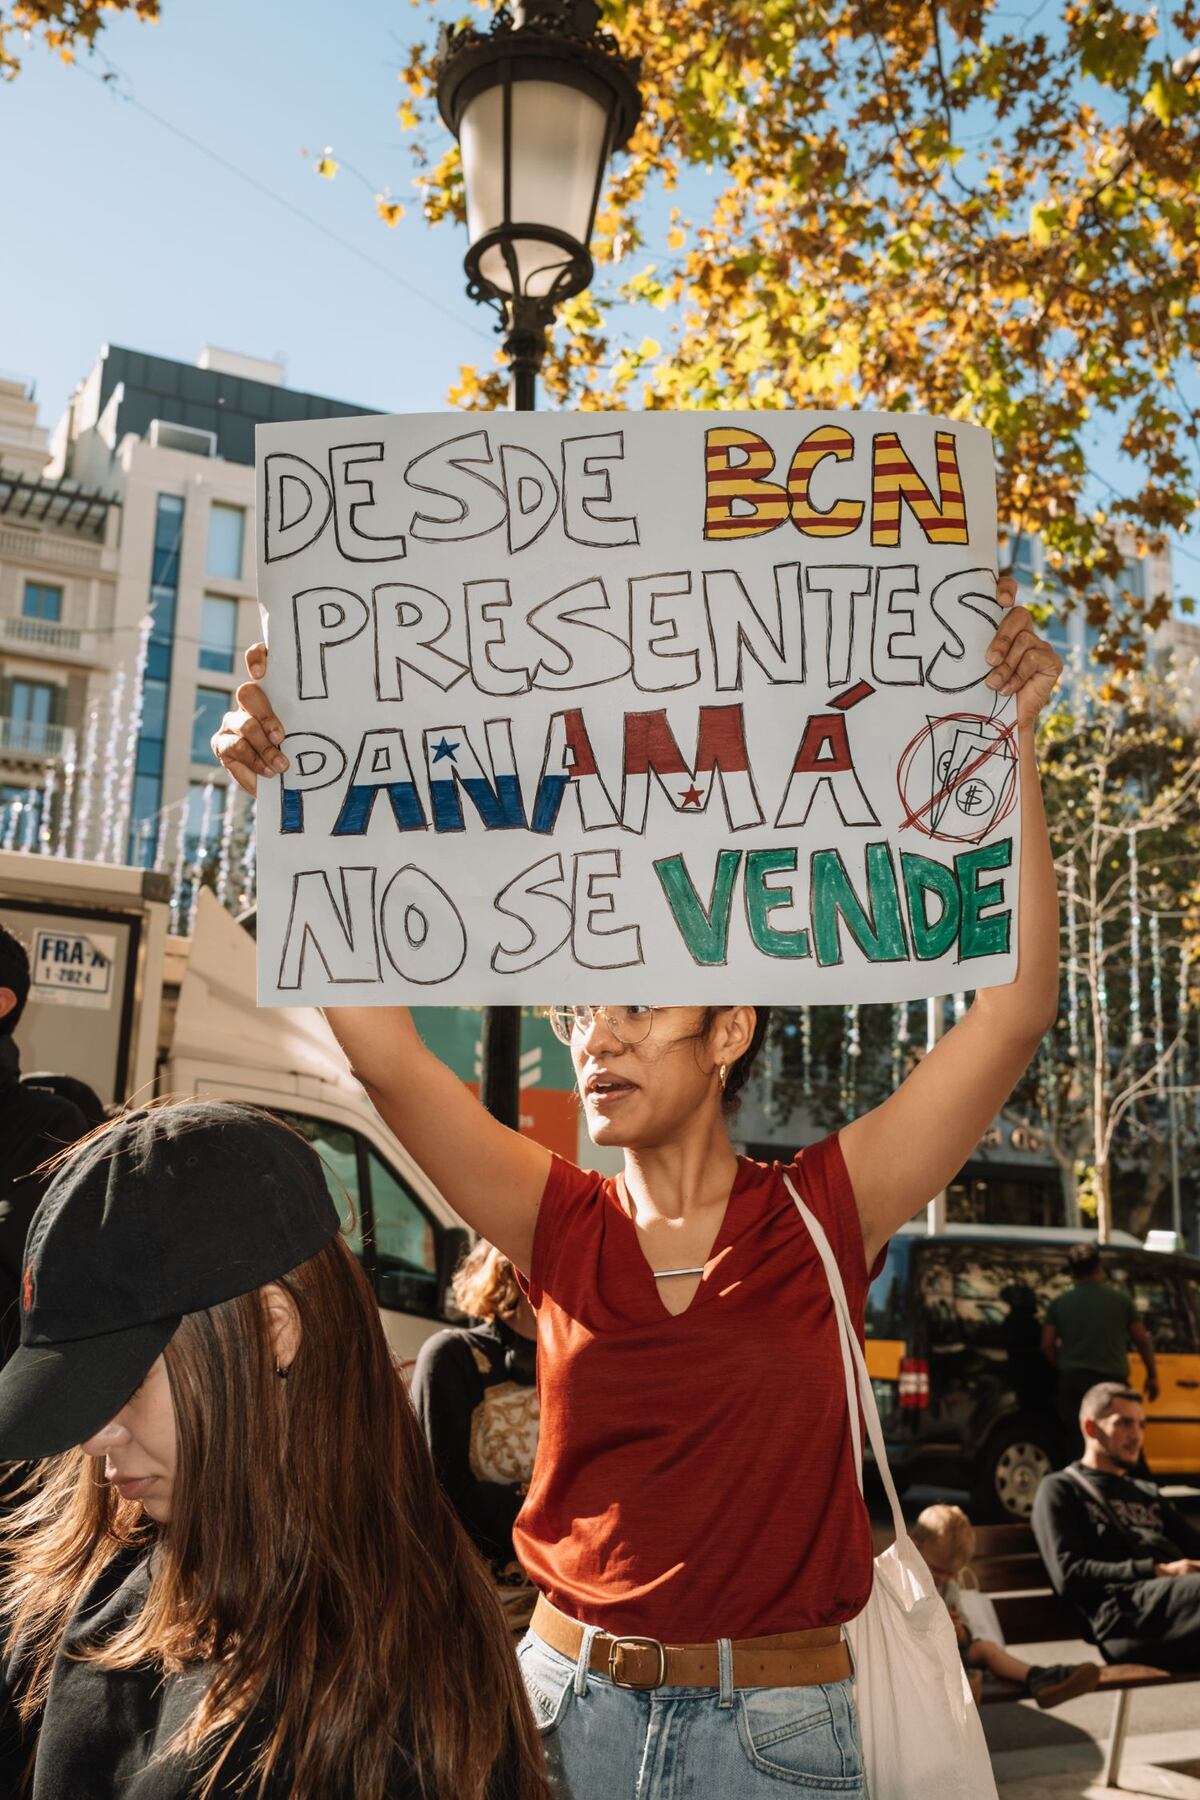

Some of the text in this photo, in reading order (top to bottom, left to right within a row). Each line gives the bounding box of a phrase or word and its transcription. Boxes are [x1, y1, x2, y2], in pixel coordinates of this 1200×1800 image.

[264, 424, 969, 563] DESDE BCN
[292, 561, 1003, 702] PRESENTES
[279, 679, 881, 836] PANAMÁ
[278, 837, 1013, 990] NO SE VENDE
